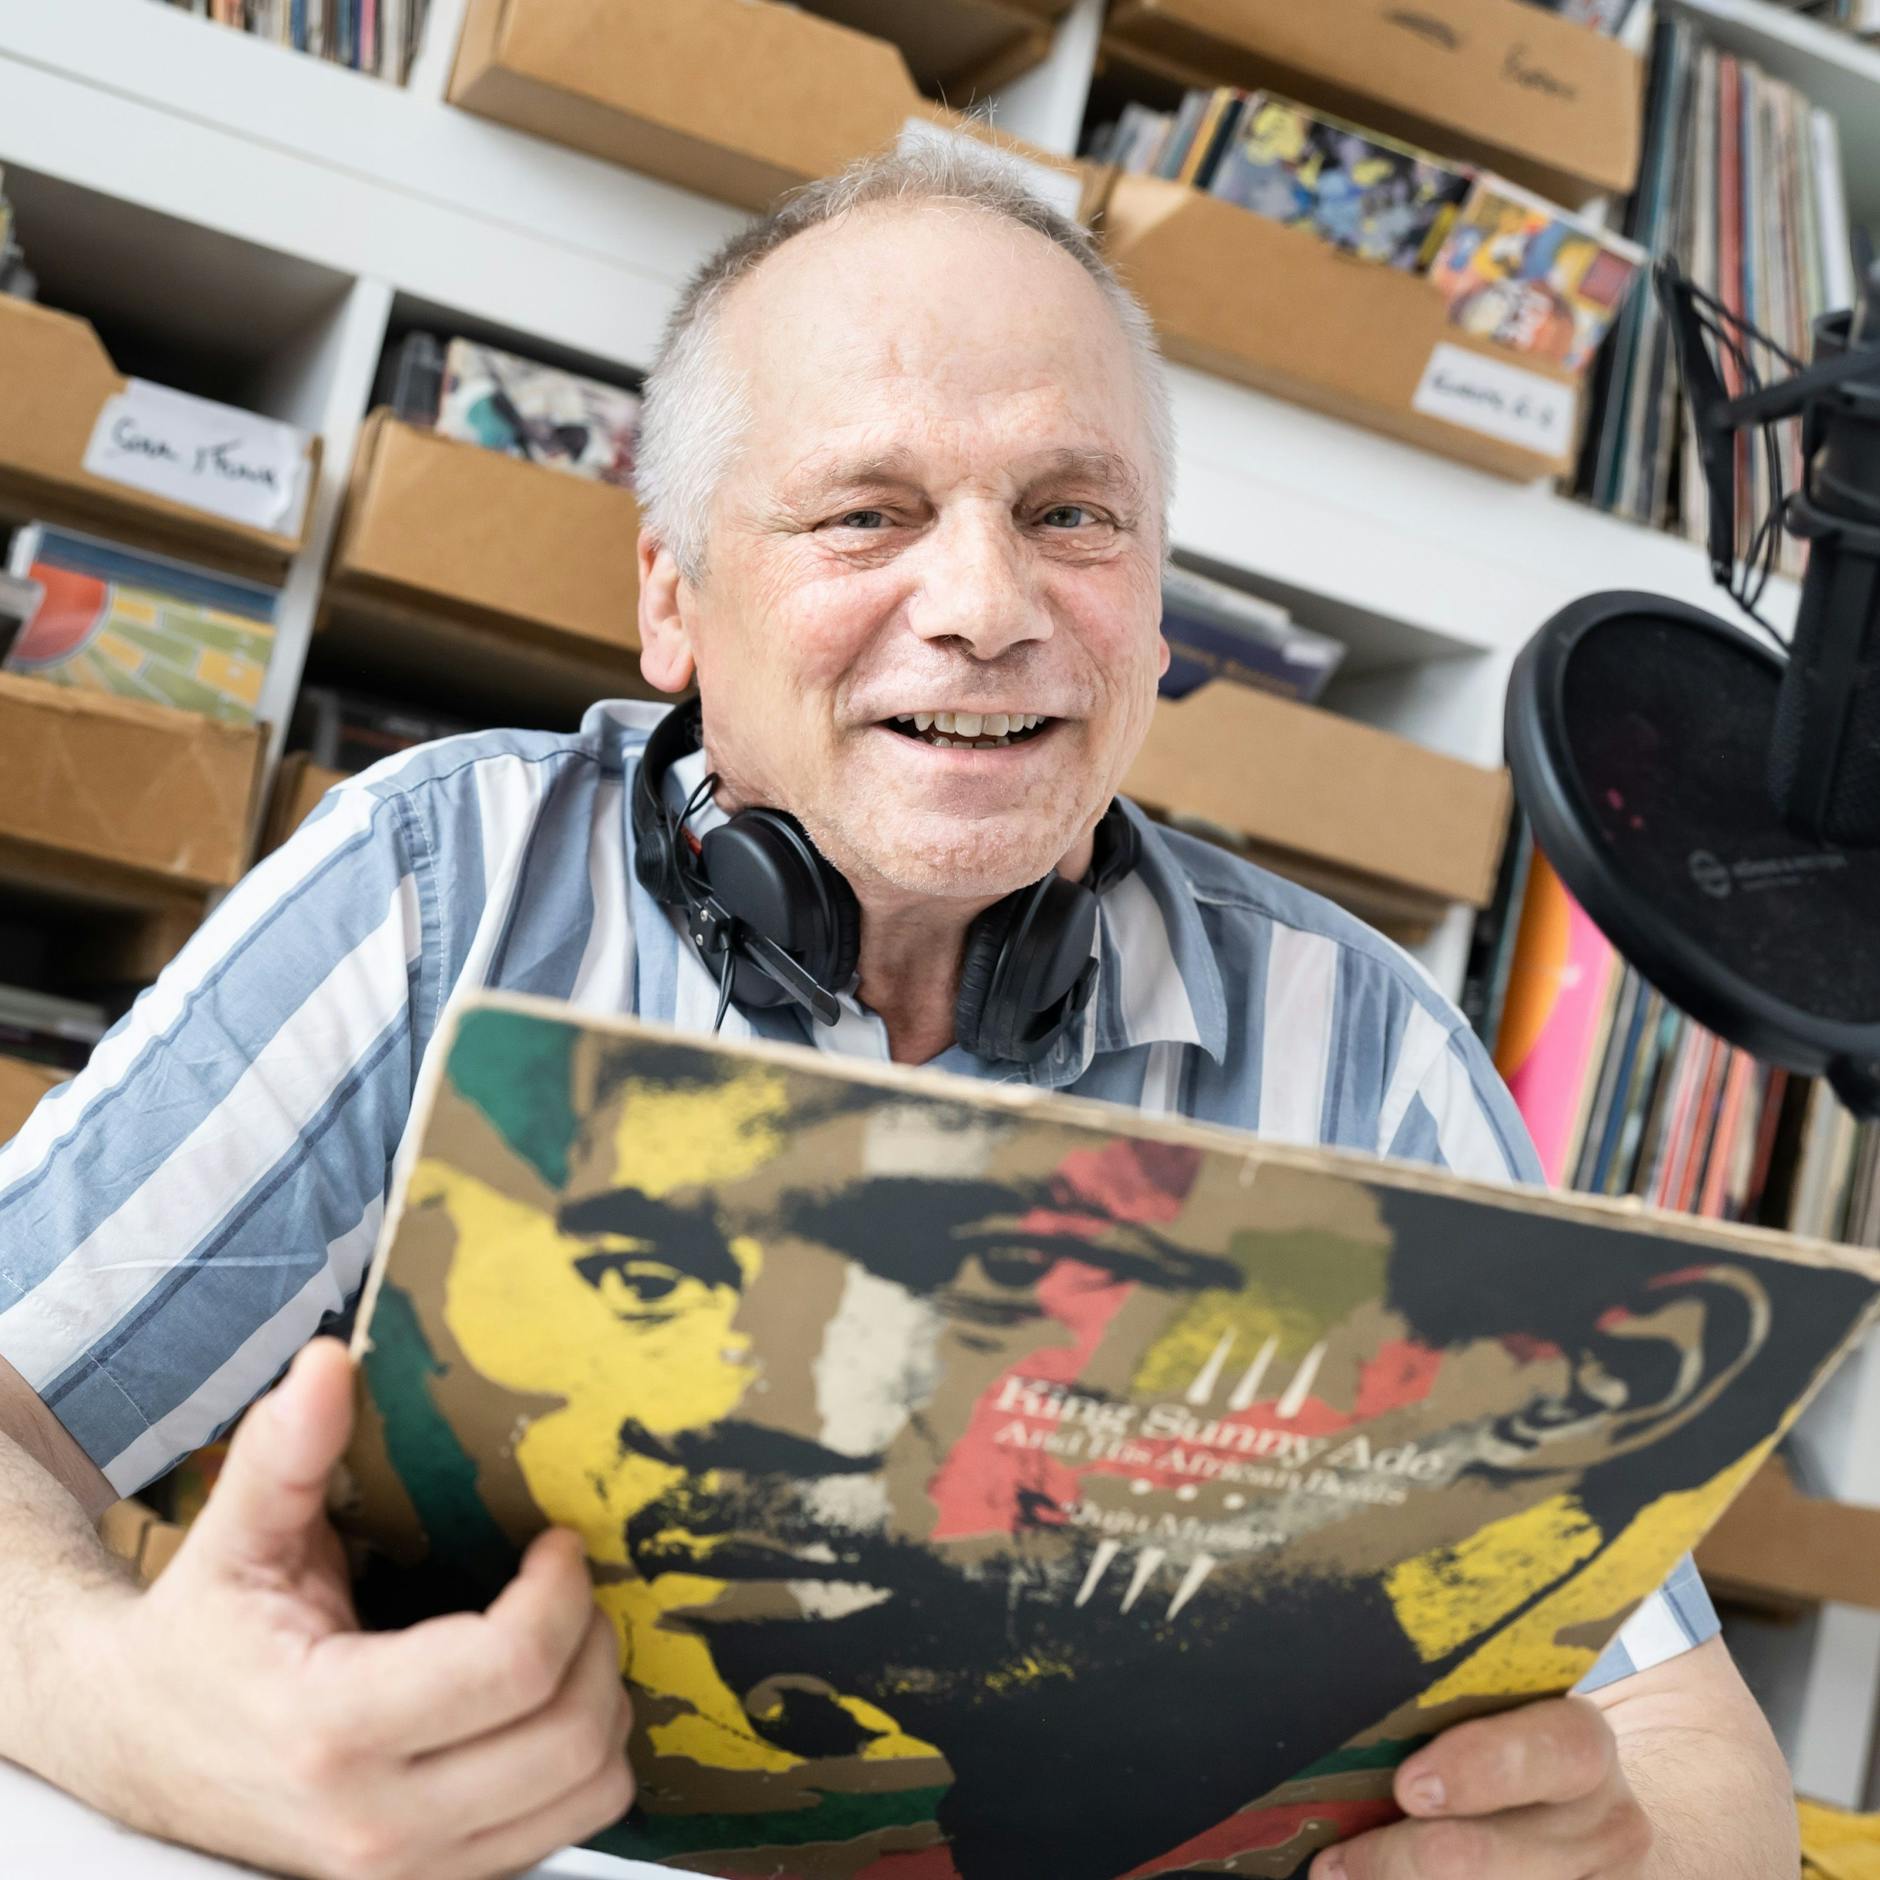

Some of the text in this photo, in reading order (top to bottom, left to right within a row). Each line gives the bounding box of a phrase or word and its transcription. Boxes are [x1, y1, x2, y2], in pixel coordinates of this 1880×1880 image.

[991, 1374, 1139, 1437] King
[1140, 1402, 1329, 1467] Sunny
[993, 1420, 1084, 1456] And
[1088, 1433, 1152, 1465] His
